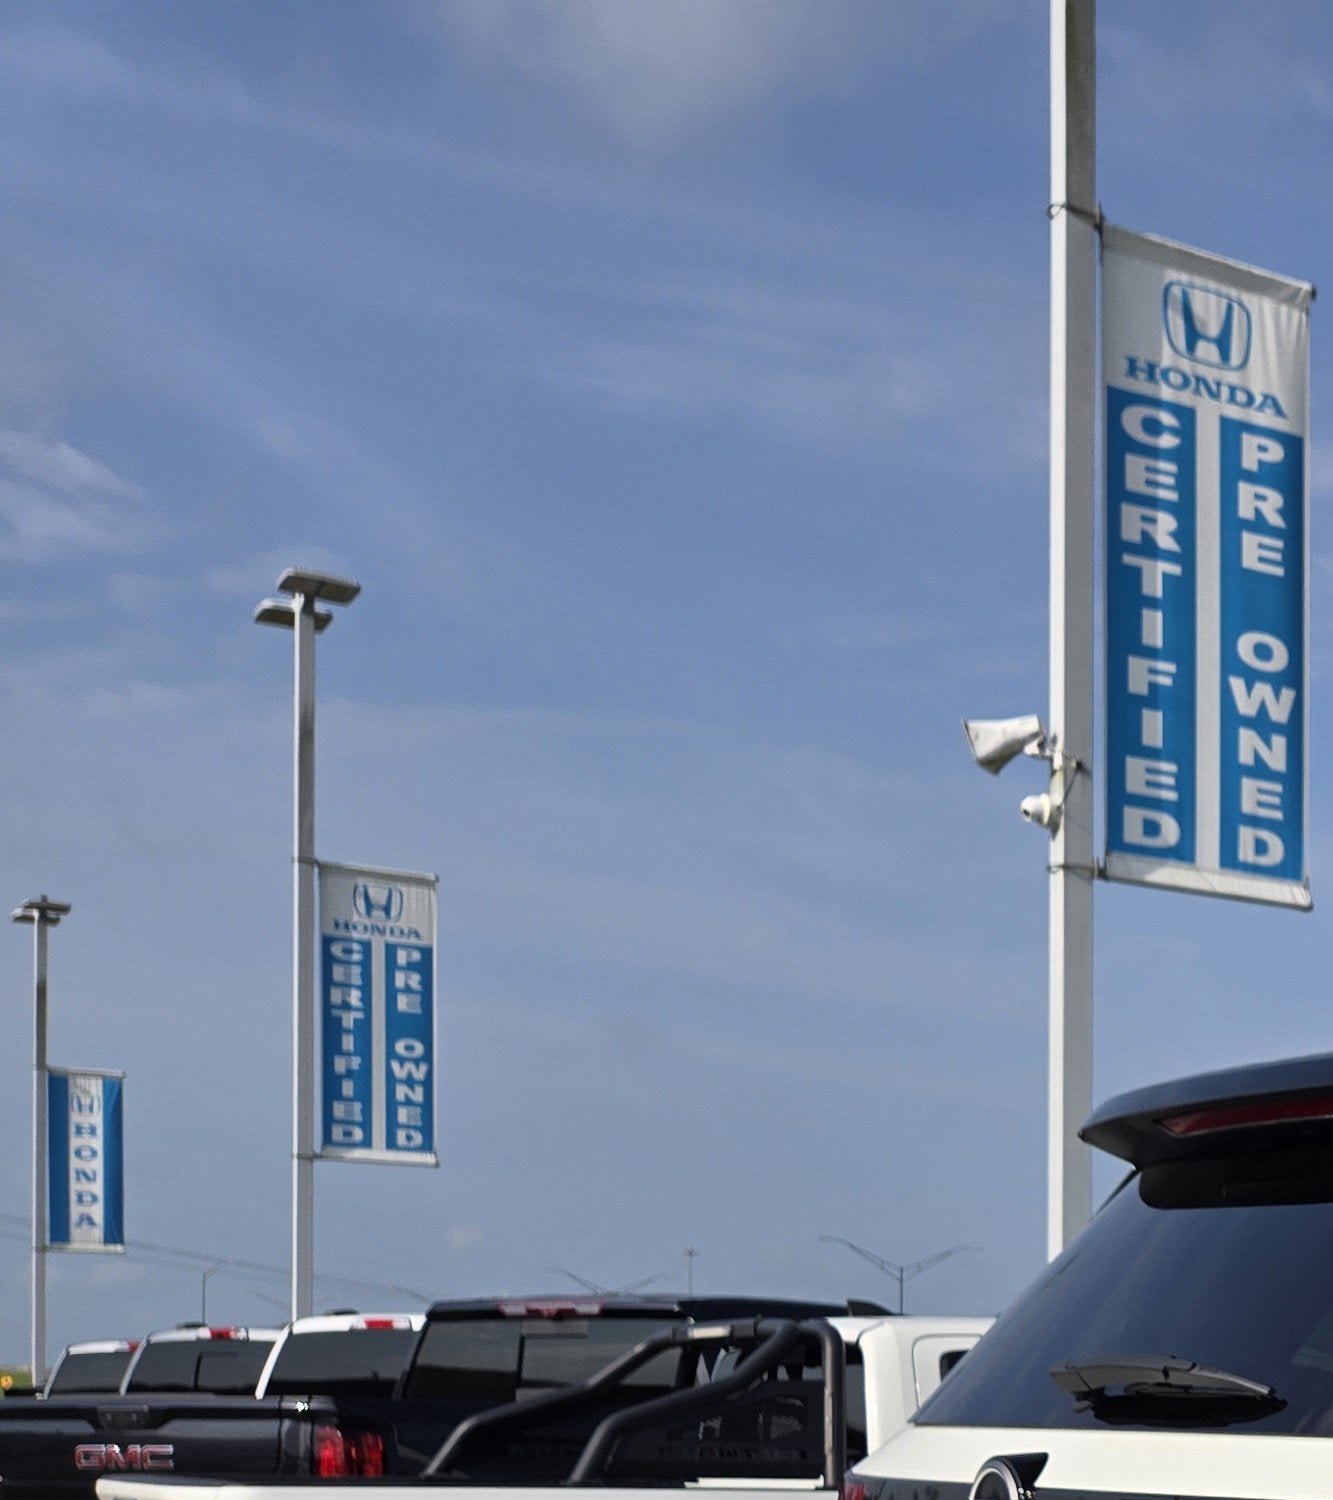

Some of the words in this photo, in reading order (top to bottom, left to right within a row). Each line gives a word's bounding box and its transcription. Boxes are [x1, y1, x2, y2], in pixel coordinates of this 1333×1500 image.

[1123, 355, 1288, 419] HONDA
[1237, 431, 1287, 577] PRE
[1119, 403, 1182, 864] CERTIFIED
[1228, 631, 1297, 868] OWNED
[333, 917, 422, 940] HONDA
[394, 947, 422, 1014] PRE
[330, 939, 364, 1146] CERTIFIED
[390, 1037, 428, 1149] OWNED
[73, 1122, 99, 1229] HONDA
[75, 1444, 175, 1471] GMC
